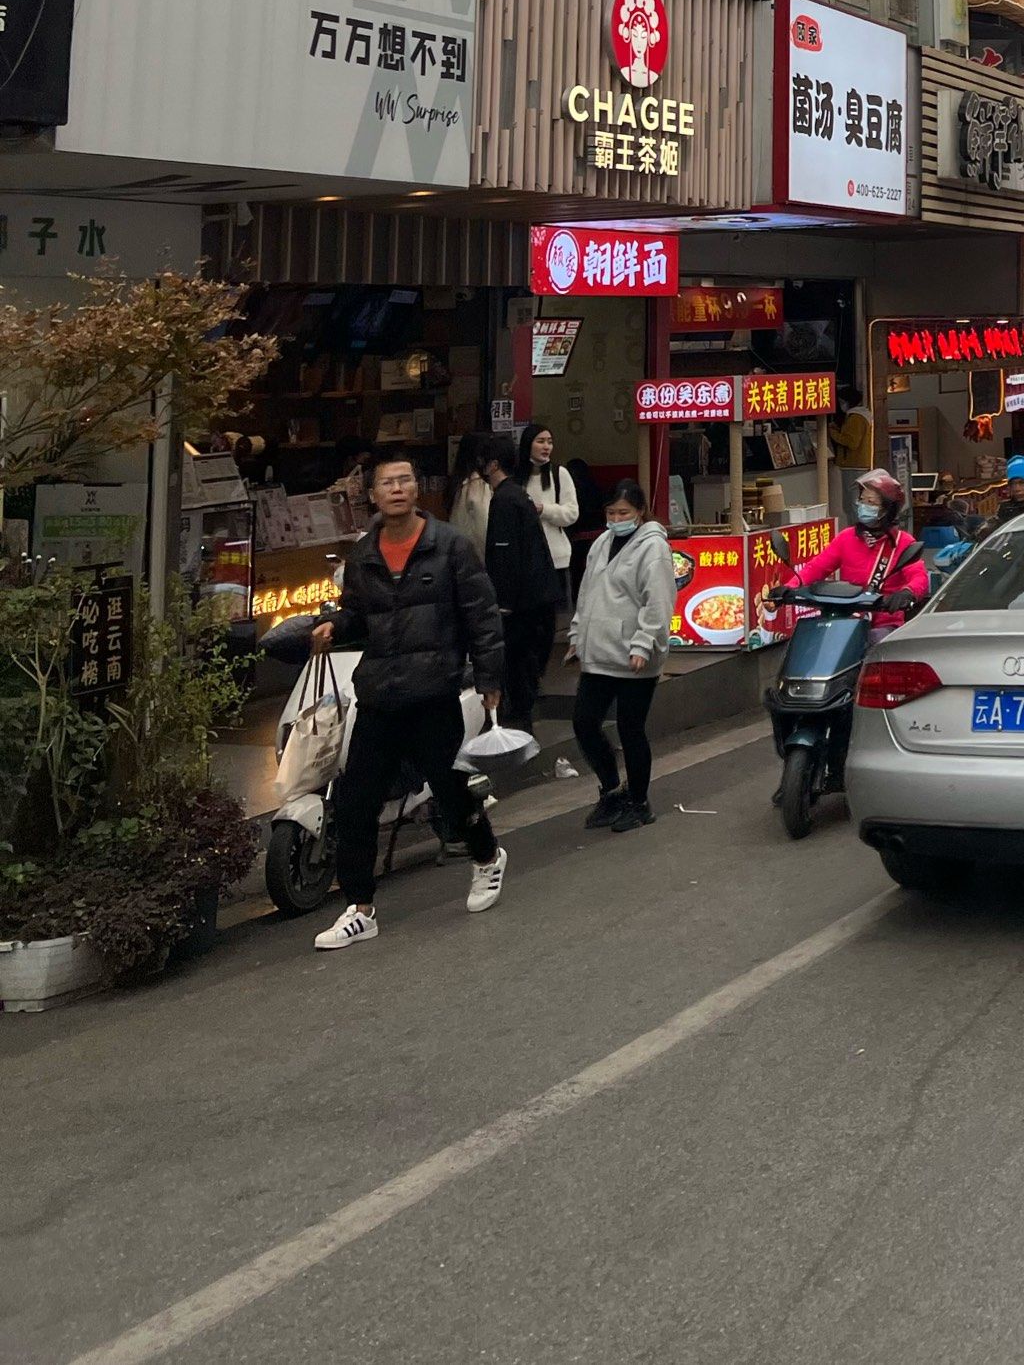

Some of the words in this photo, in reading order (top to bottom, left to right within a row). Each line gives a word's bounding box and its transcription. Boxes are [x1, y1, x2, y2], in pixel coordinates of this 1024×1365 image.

[309, 10, 467, 83] 万万想不到
[402, 93, 460, 133] Surprise
[568, 85, 695, 136] CHAGEE
[792, 72, 903, 155] 菌汤·臭豆腐
[594, 130, 679, 176] 霸王茶姬
[856, 183, 902, 202] 400-625-2227
[583, 239, 668, 288] 朝鲜面
[641, 384, 730, 406] 来份关东煮
[748, 381, 789, 414] 关东煮
[792, 377, 832, 410] 月亮馍
[699, 550, 739, 568] 酸辣粉
[81, 598, 99, 686] 必吃榜
[107, 596, 123, 683] 逛云南
